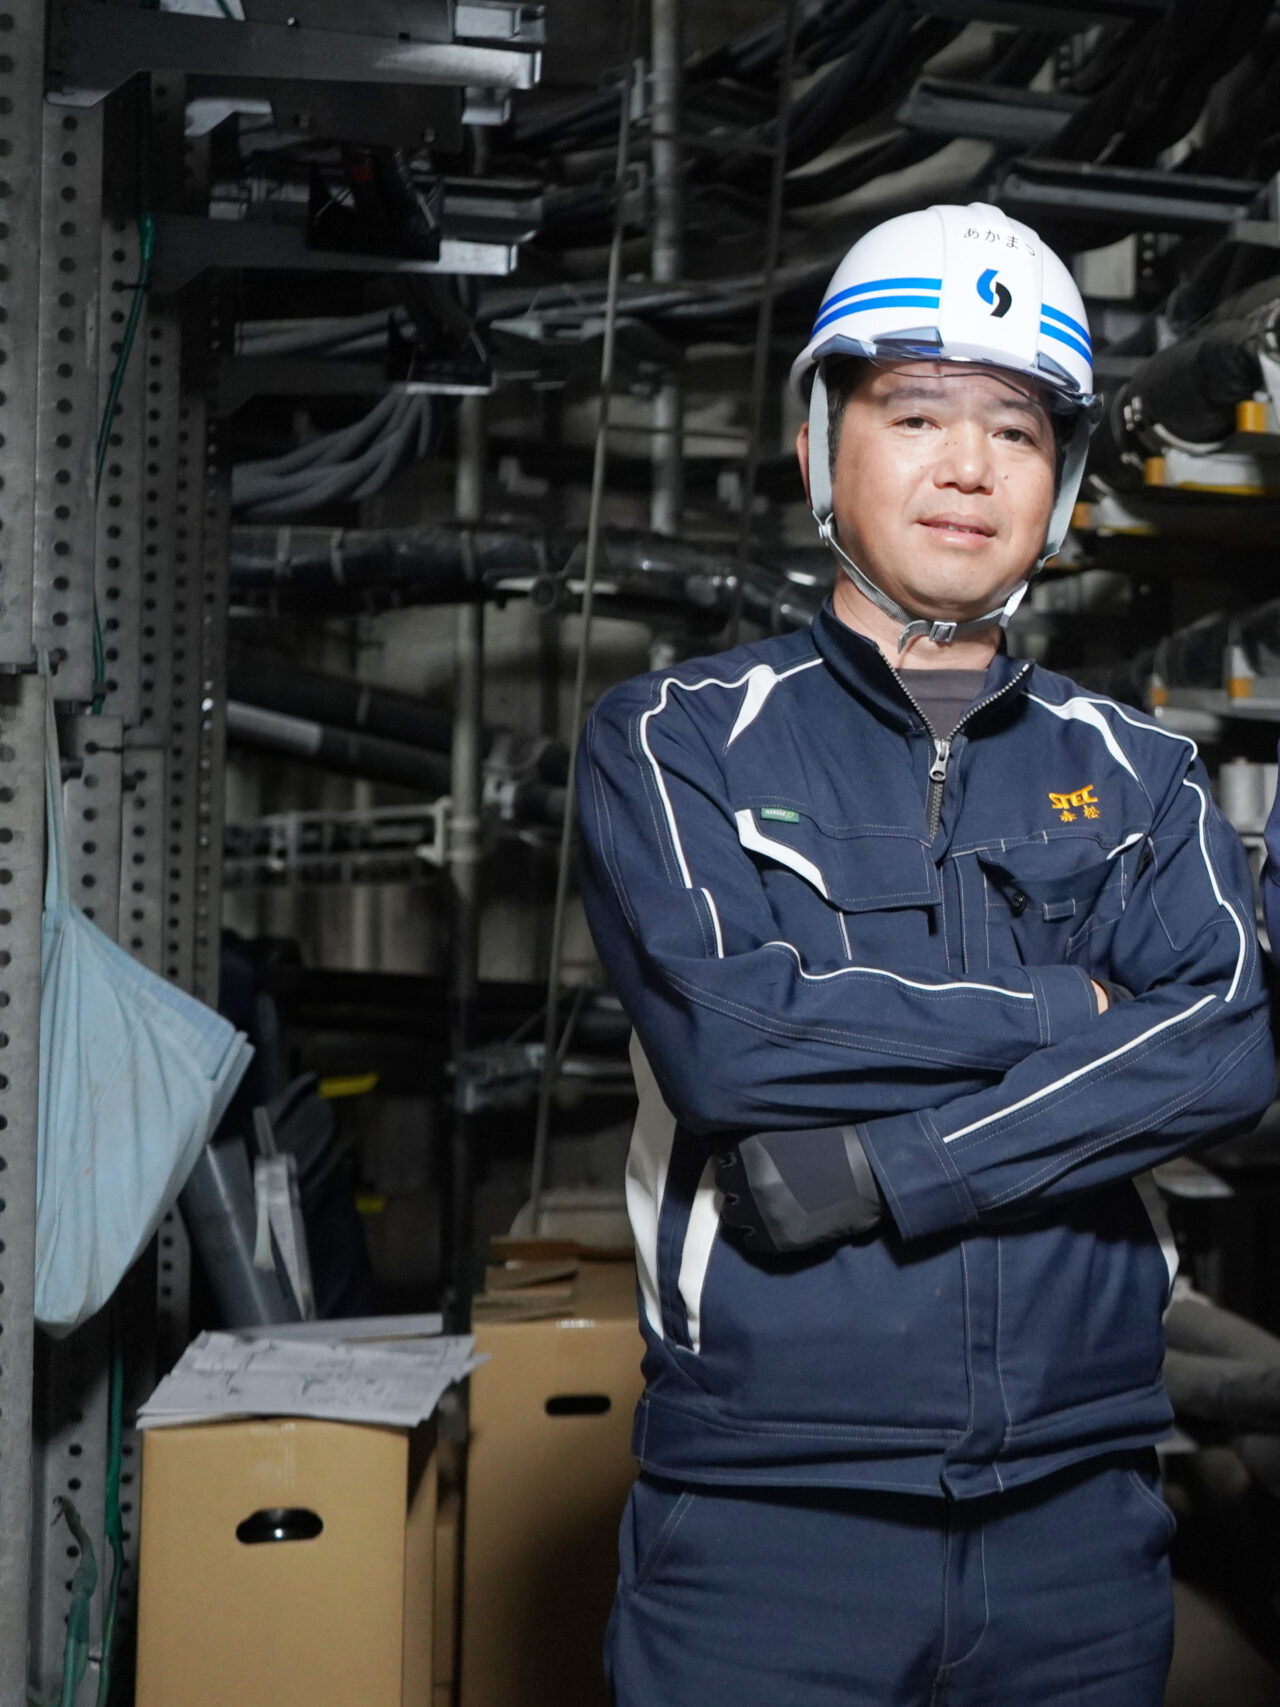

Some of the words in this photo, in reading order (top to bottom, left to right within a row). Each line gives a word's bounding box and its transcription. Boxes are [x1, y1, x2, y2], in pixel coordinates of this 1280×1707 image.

[963, 227, 1036, 257] あかまつ
[1048, 784, 1099, 809] STEC
